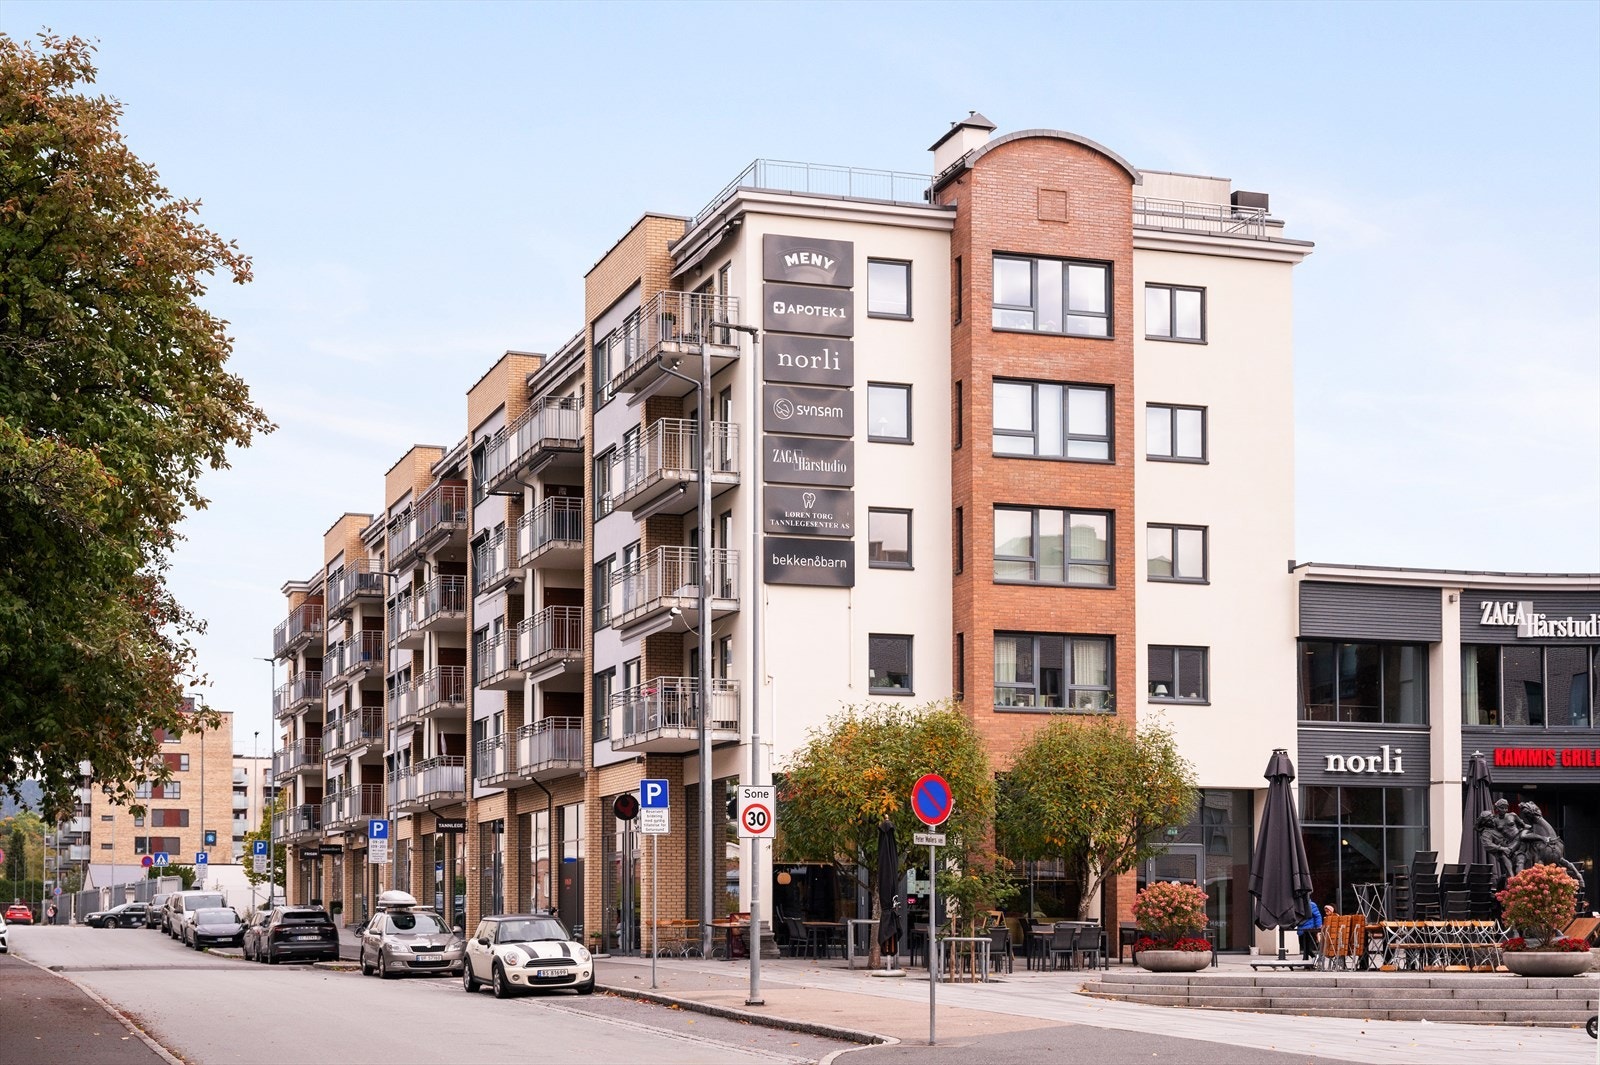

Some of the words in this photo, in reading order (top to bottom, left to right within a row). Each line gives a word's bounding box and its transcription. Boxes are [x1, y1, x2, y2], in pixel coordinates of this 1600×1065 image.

[784, 252, 835, 270] MENY
[786, 303, 838, 318] APOTEK
[839, 307, 846, 318] 1
[777, 348, 841, 370] norli
[796, 404, 843, 418] SYNSAM
[773, 448, 799, 464] ZAGA
[798, 456, 847, 473] Hårstudio
[785, 511, 811, 519] LØREN
[812, 512, 833, 520] TORG
[770, 519, 839, 529] TANNLEGESENTER
[772, 553, 847, 568] bekkenåbarn
[1480, 601, 1527, 626] ZAGA
[1324, 744, 1405, 774] norli
[1494, 748, 1556, 767] KAMMIS
[647, 783, 662, 805] P
[744, 789, 769, 799] Sone
[747, 811, 766, 827] 30
[373, 822, 384, 837] P
[256, 842, 264, 853] P
